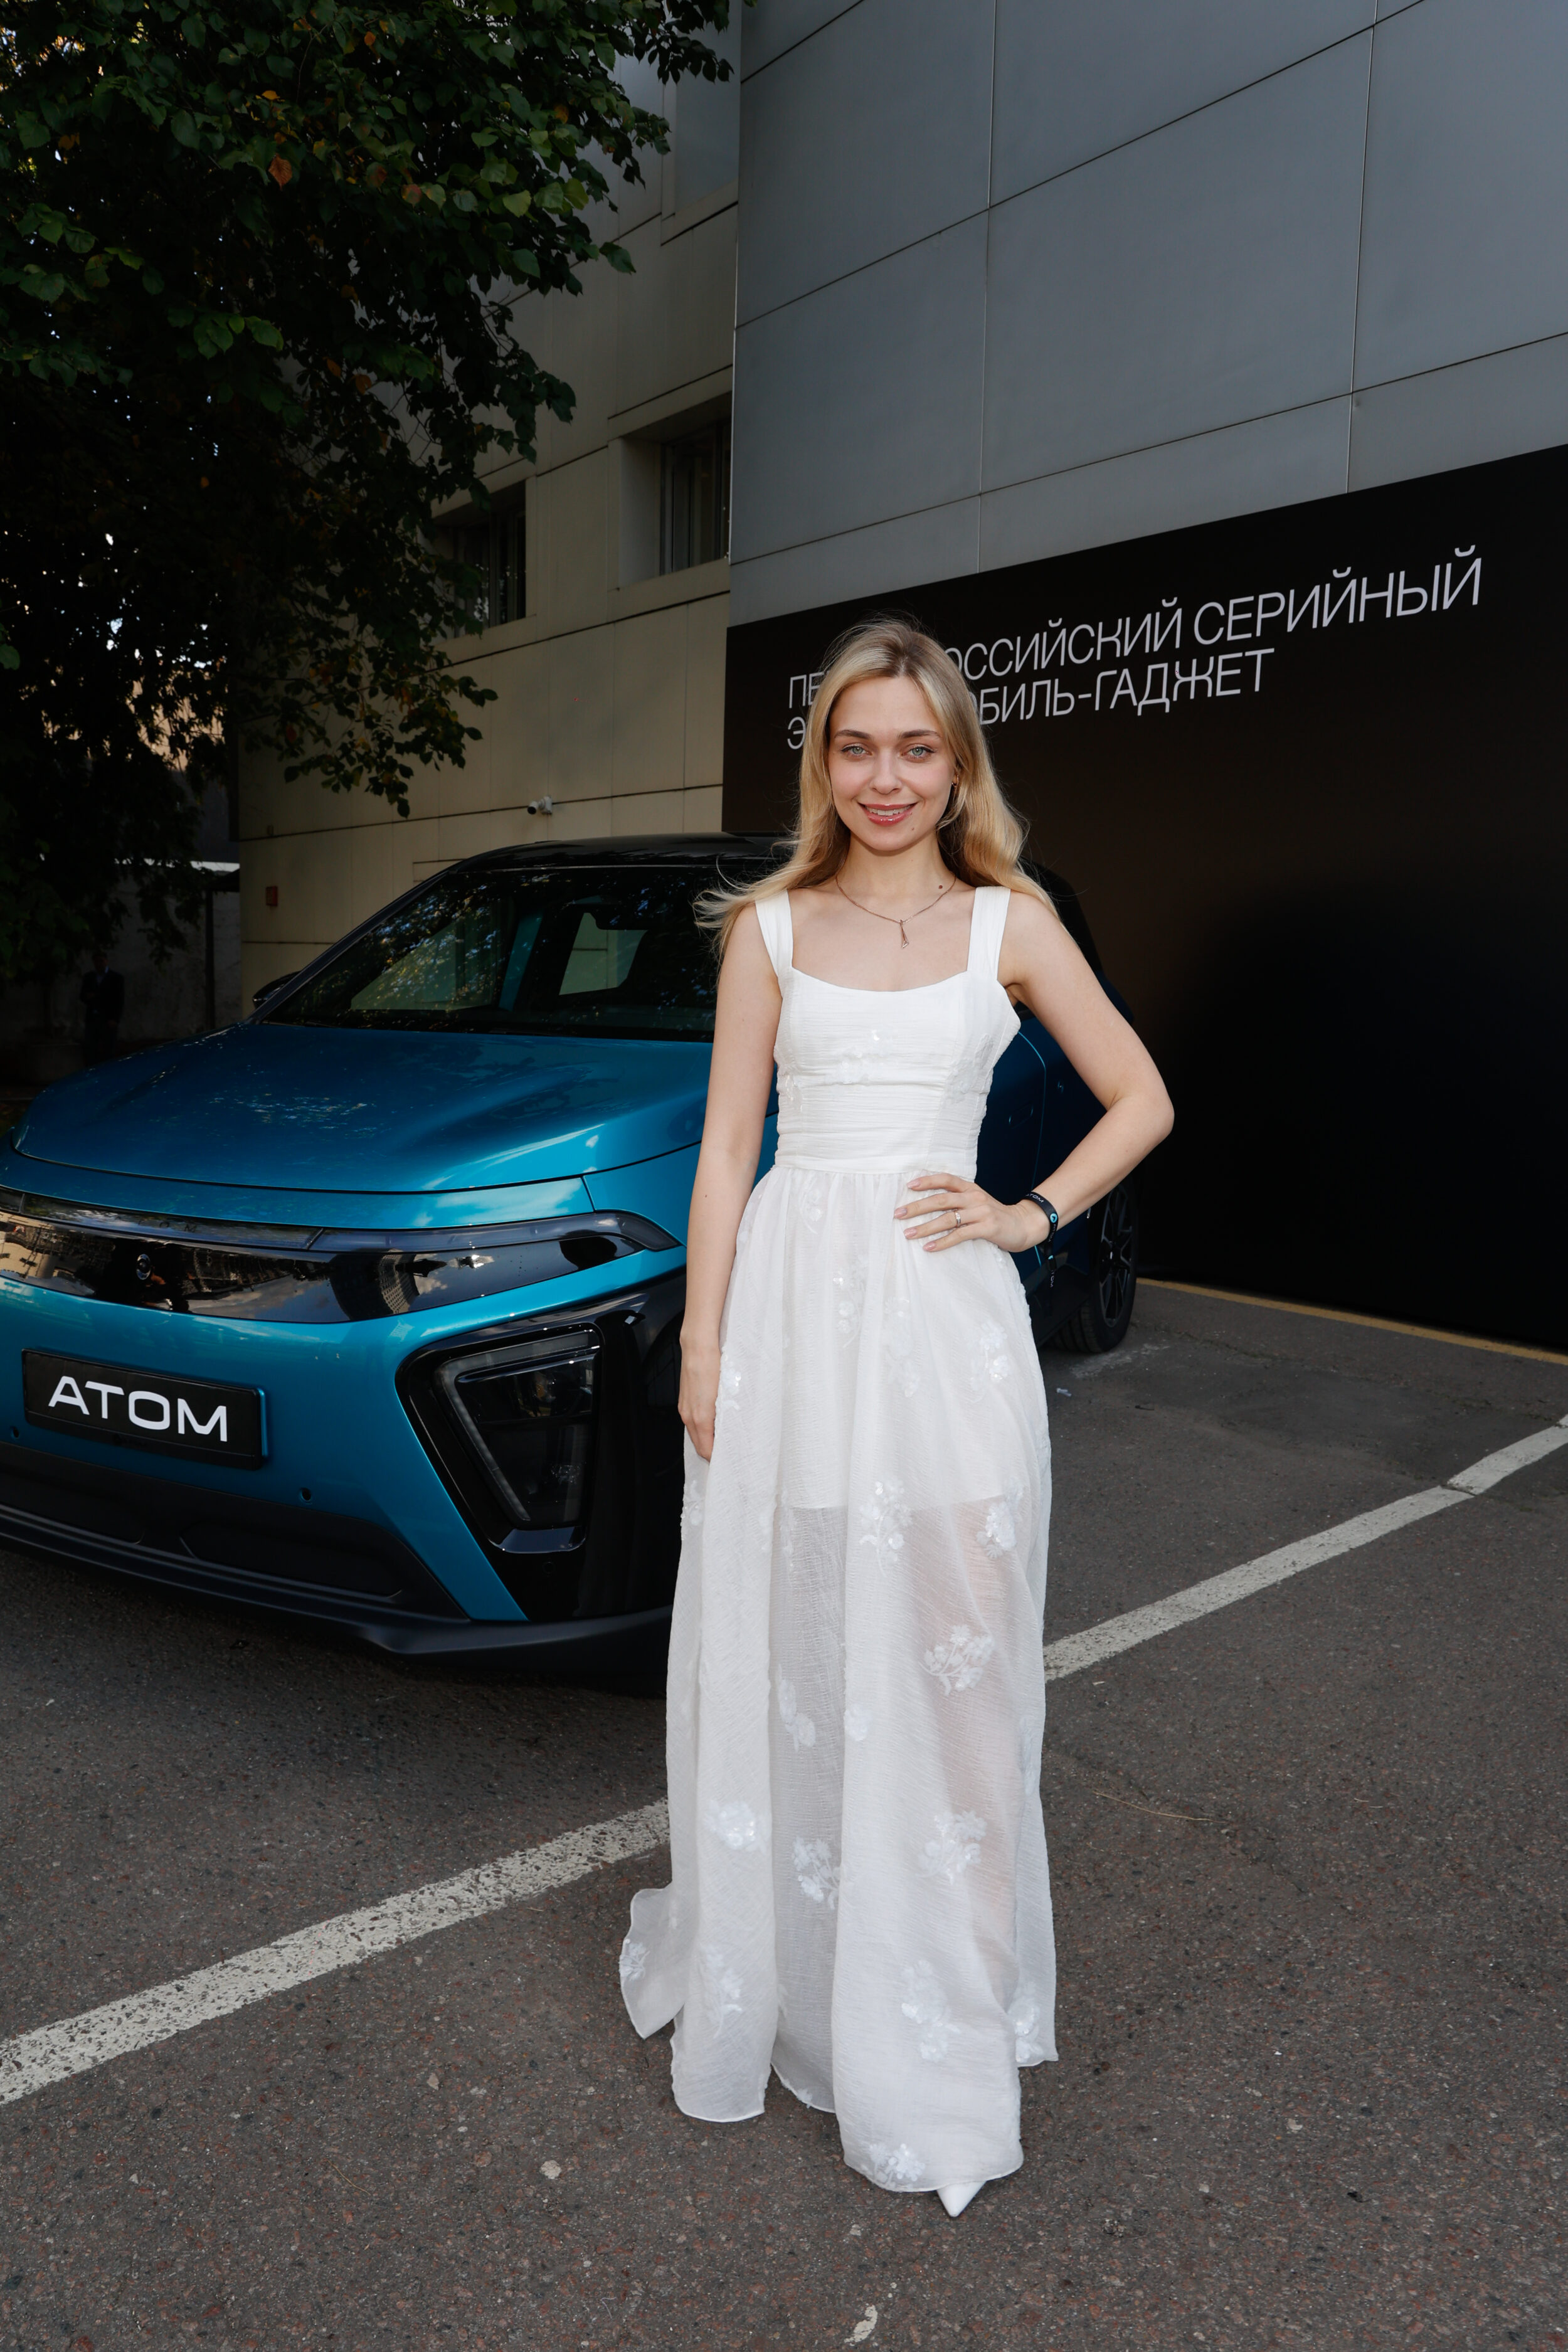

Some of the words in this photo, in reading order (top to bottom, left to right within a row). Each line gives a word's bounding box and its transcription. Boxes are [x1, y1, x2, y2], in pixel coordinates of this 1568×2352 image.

[945, 596, 1182, 681] ССИЙСКИЙ
[1194, 544, 1482, 645] СЕРИЙНЫЙ
[48, 1375, 228, 1442] ATOM
